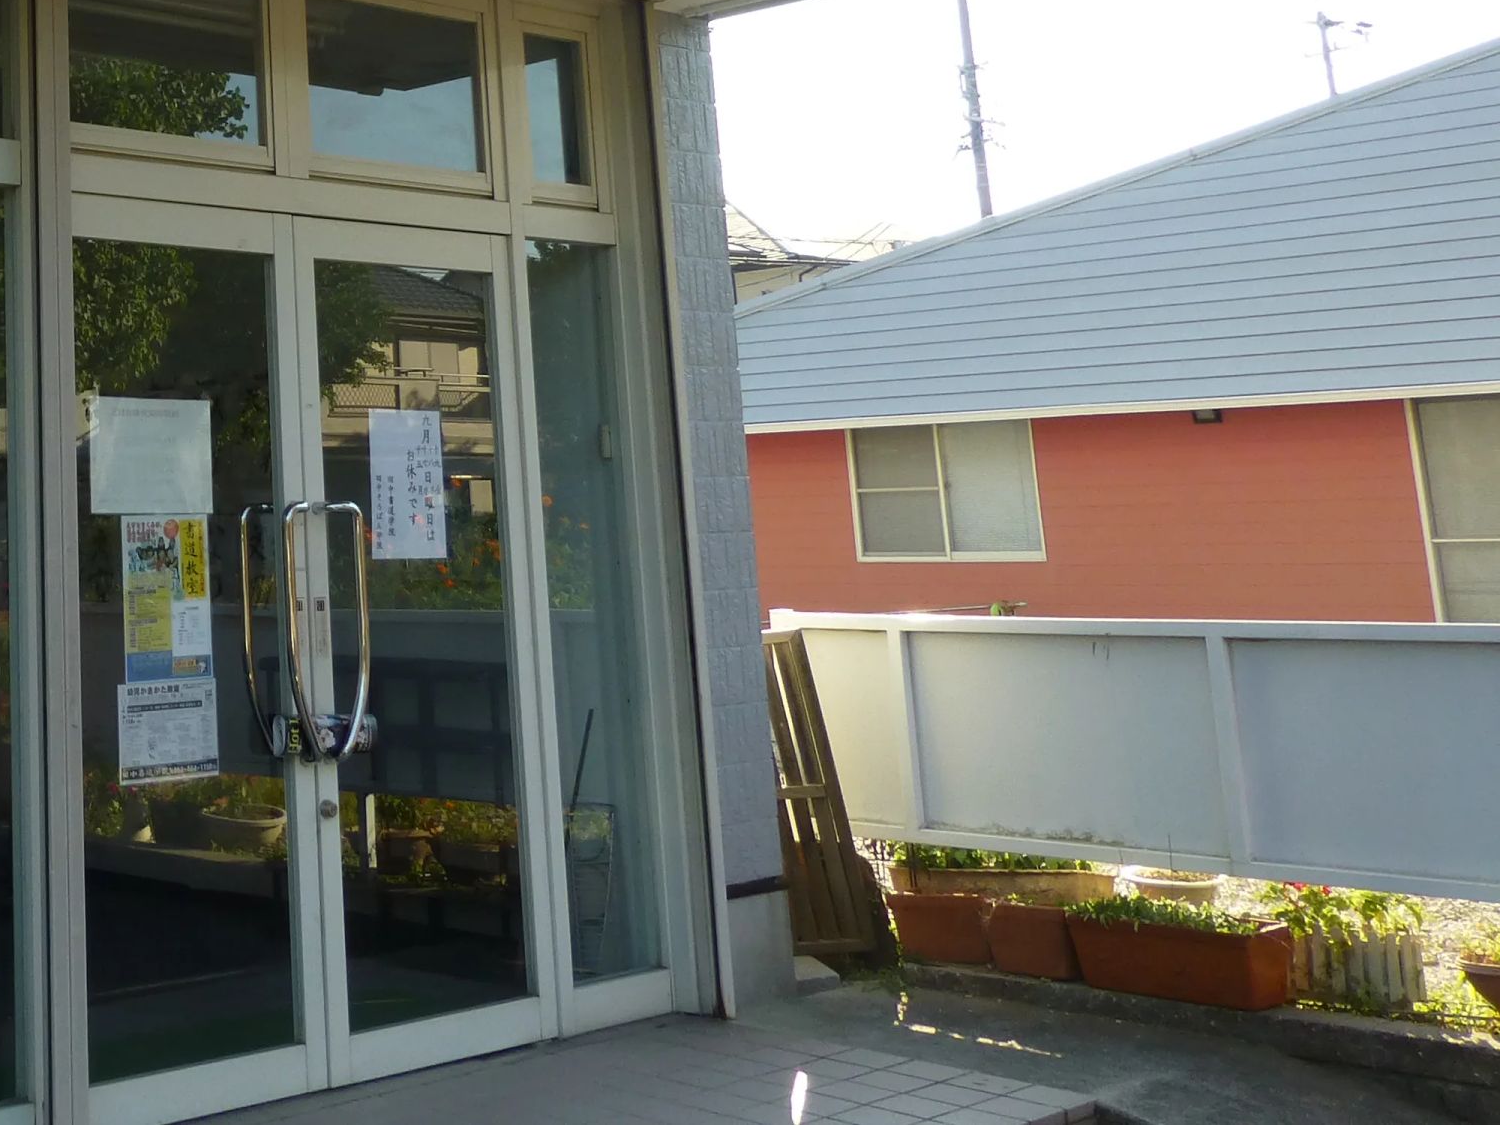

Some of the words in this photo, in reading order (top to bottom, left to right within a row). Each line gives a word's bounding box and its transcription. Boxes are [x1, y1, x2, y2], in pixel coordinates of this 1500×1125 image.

[406, 449, 418, 526] お休みです
